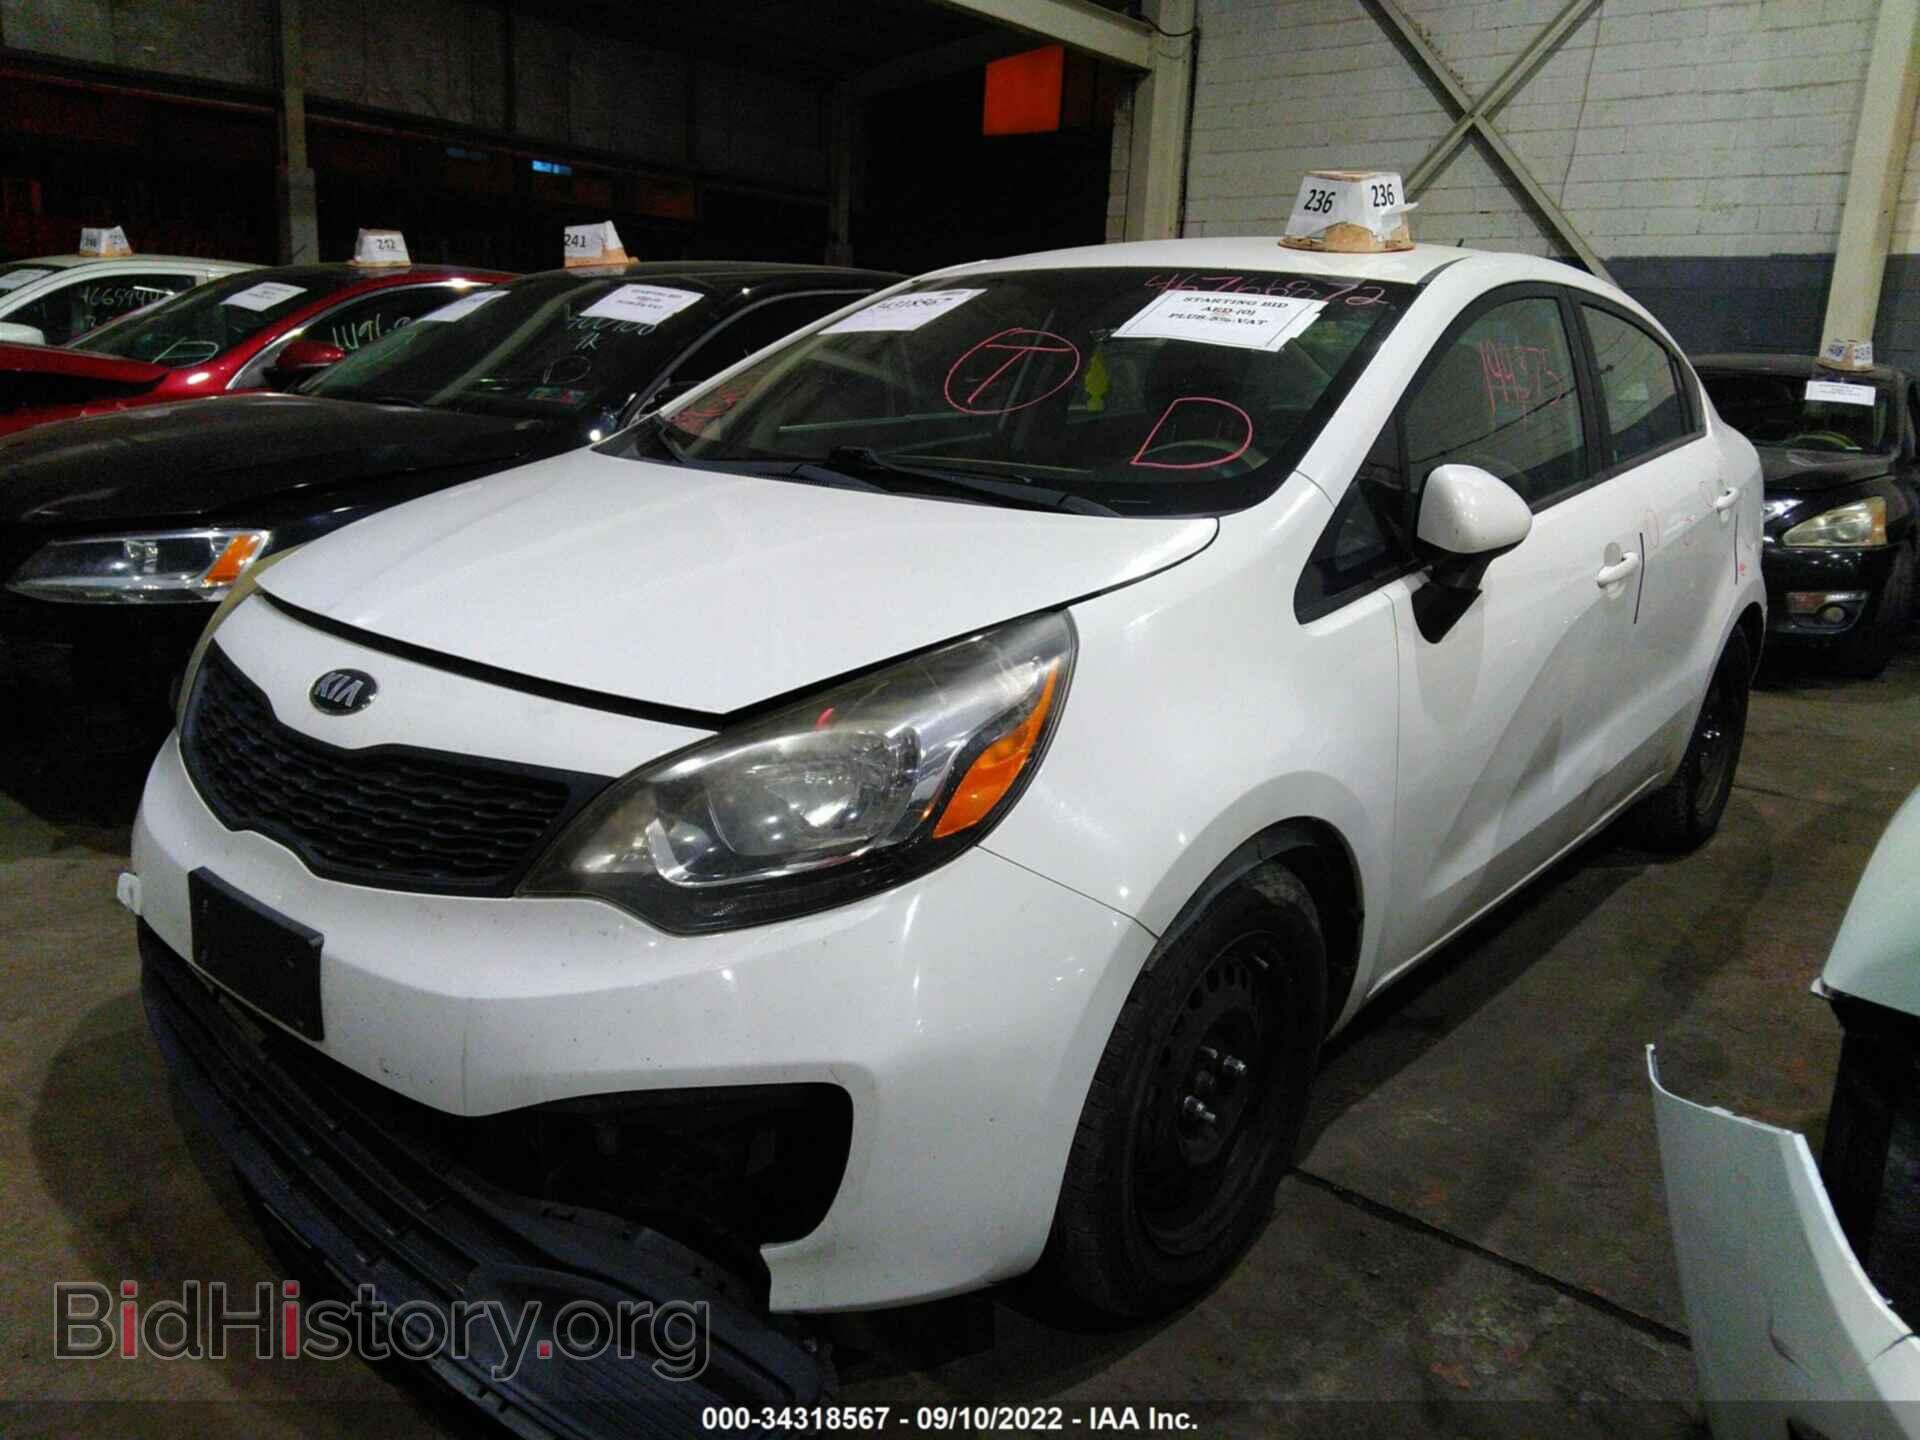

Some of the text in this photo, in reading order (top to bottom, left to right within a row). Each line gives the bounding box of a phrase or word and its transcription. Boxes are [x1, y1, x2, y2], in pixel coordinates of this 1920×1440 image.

[1303, 188, 1336, 214] 236
[1371, 183, 1396, 208] 236
[562, 233, 587, 248] 241
[1183, 296, 1289, 308] STARTING BID
[313, 672, 365, 708] KIA
